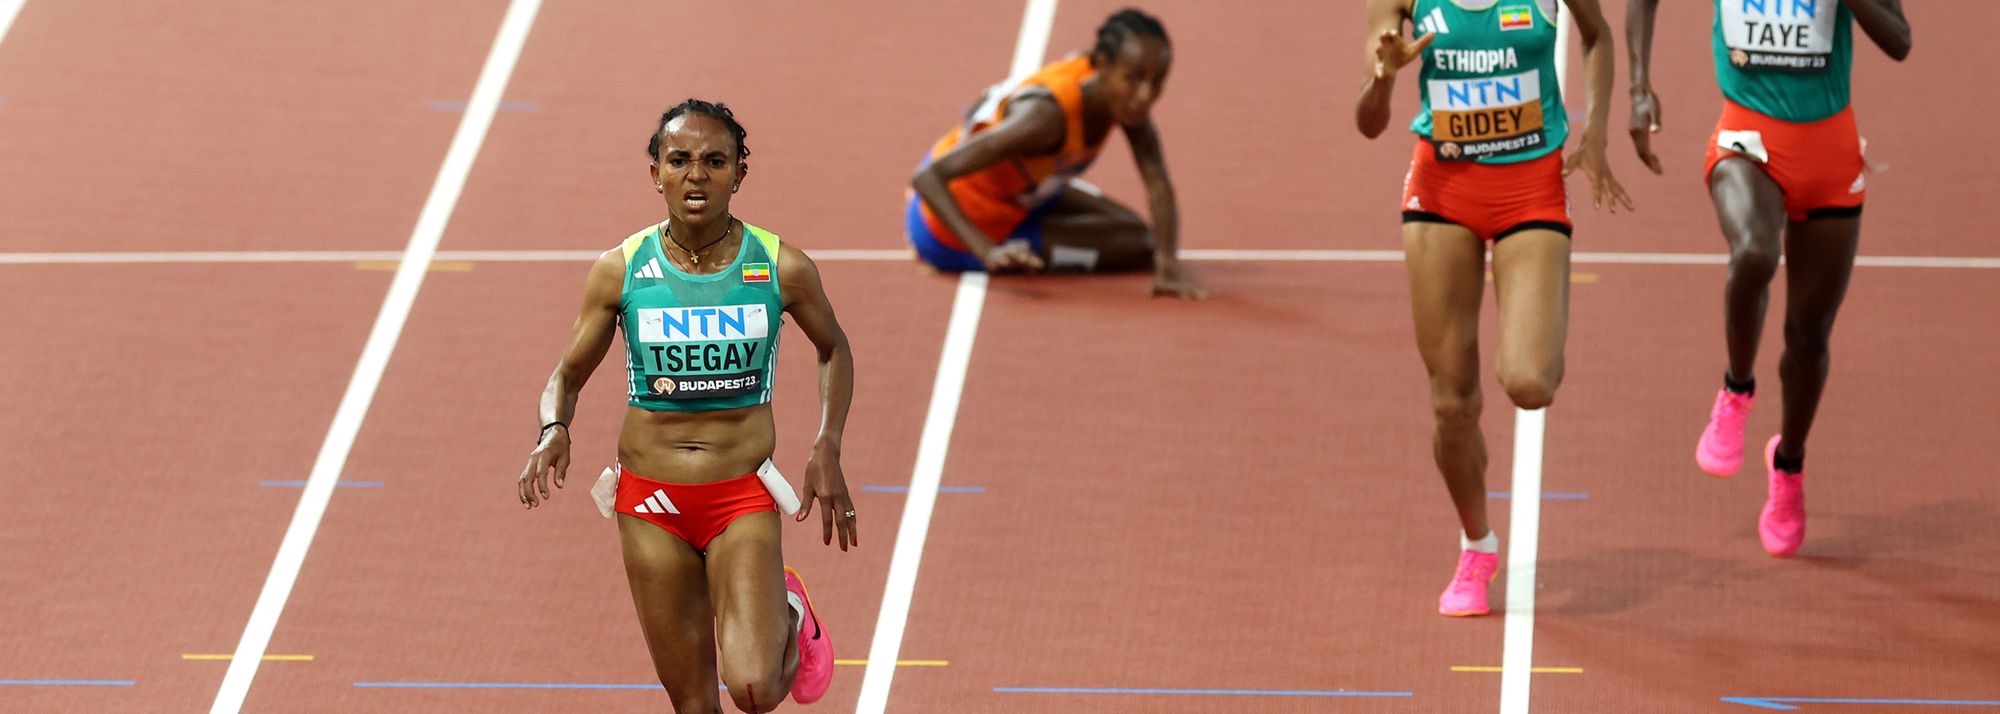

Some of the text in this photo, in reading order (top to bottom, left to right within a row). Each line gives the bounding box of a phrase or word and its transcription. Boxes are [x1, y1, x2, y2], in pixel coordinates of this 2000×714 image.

[1745, 22, 1809, 48] TAYE
[1434, 47, 1518, 73] ETHIOPIA
[1447, 77, 1521, 107] NTN
[1450, 108, 1523, 138] GIDEY
[662, 307, 745, 339] NTN
[649, 342, 758, 372] TSEGAY
